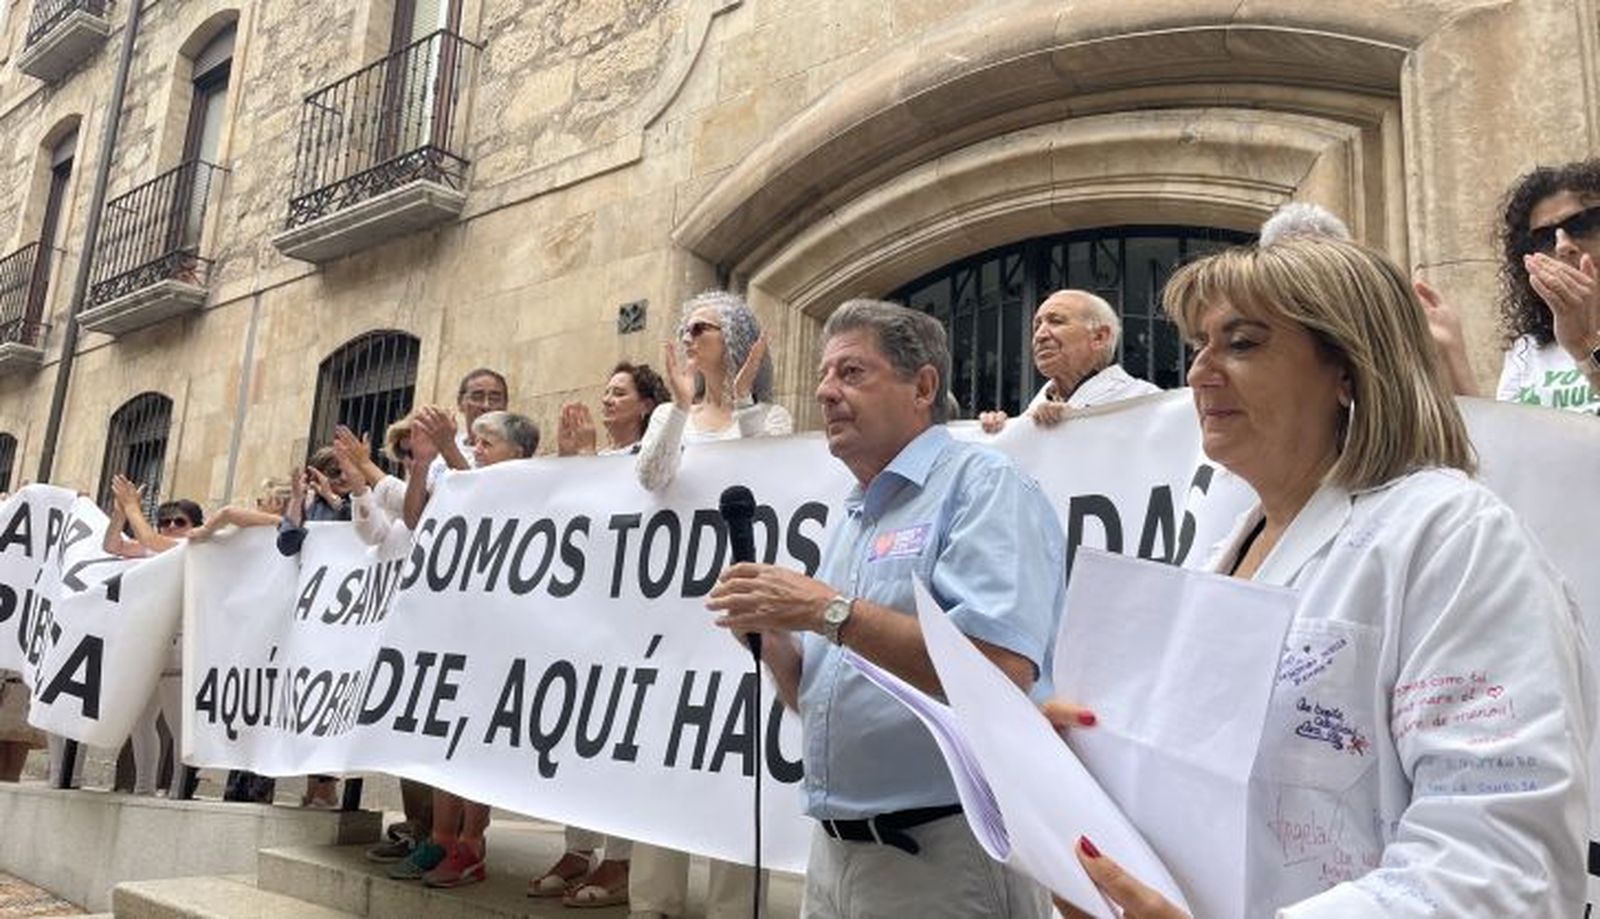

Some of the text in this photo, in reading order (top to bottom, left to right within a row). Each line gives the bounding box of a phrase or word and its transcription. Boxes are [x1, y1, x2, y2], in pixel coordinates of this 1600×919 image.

[399, 515, 592, 598] SOMOS
[195, 646, 279, 741] AQUÍ
[484, 634, 663, 779] AQUÍ
